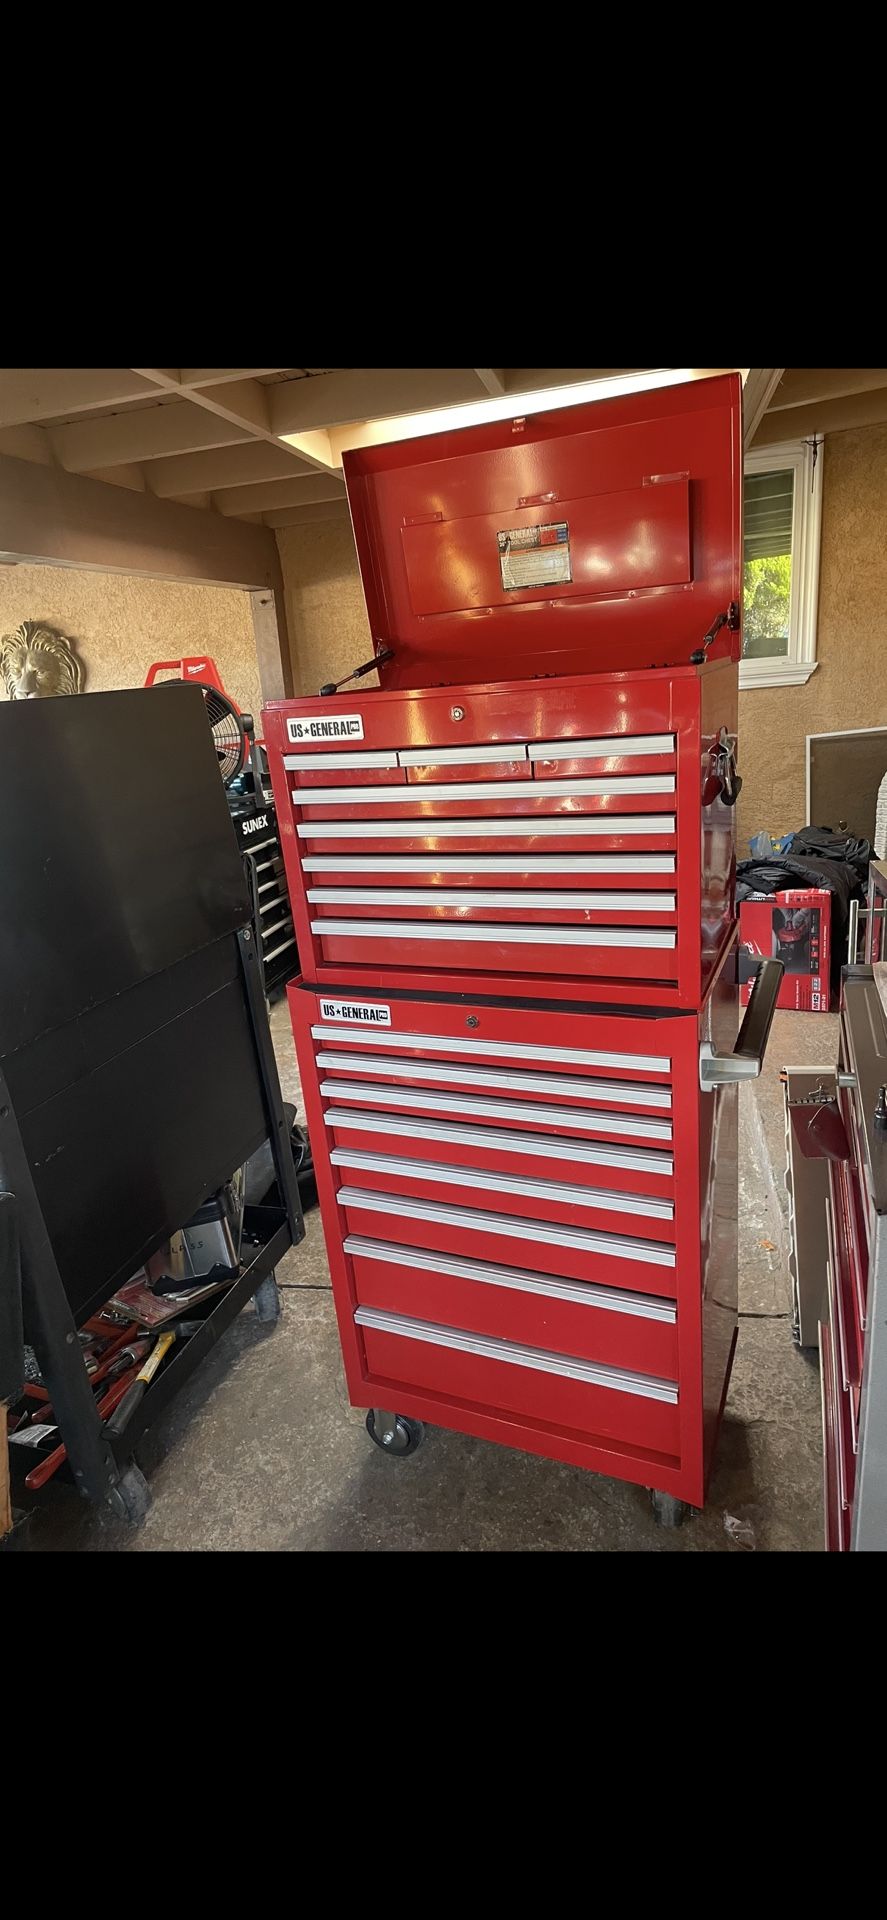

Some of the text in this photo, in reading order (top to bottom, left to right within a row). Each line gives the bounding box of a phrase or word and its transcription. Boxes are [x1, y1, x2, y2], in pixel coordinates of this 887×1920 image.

[290, 723, 304, 738] US
[310, 720, 353, 737] GENERAL
[242, 814, 268, 835] SUNEX
[323, 1004, 335, 1016] US
[341, 1006, 381, 1021] GENERAL
